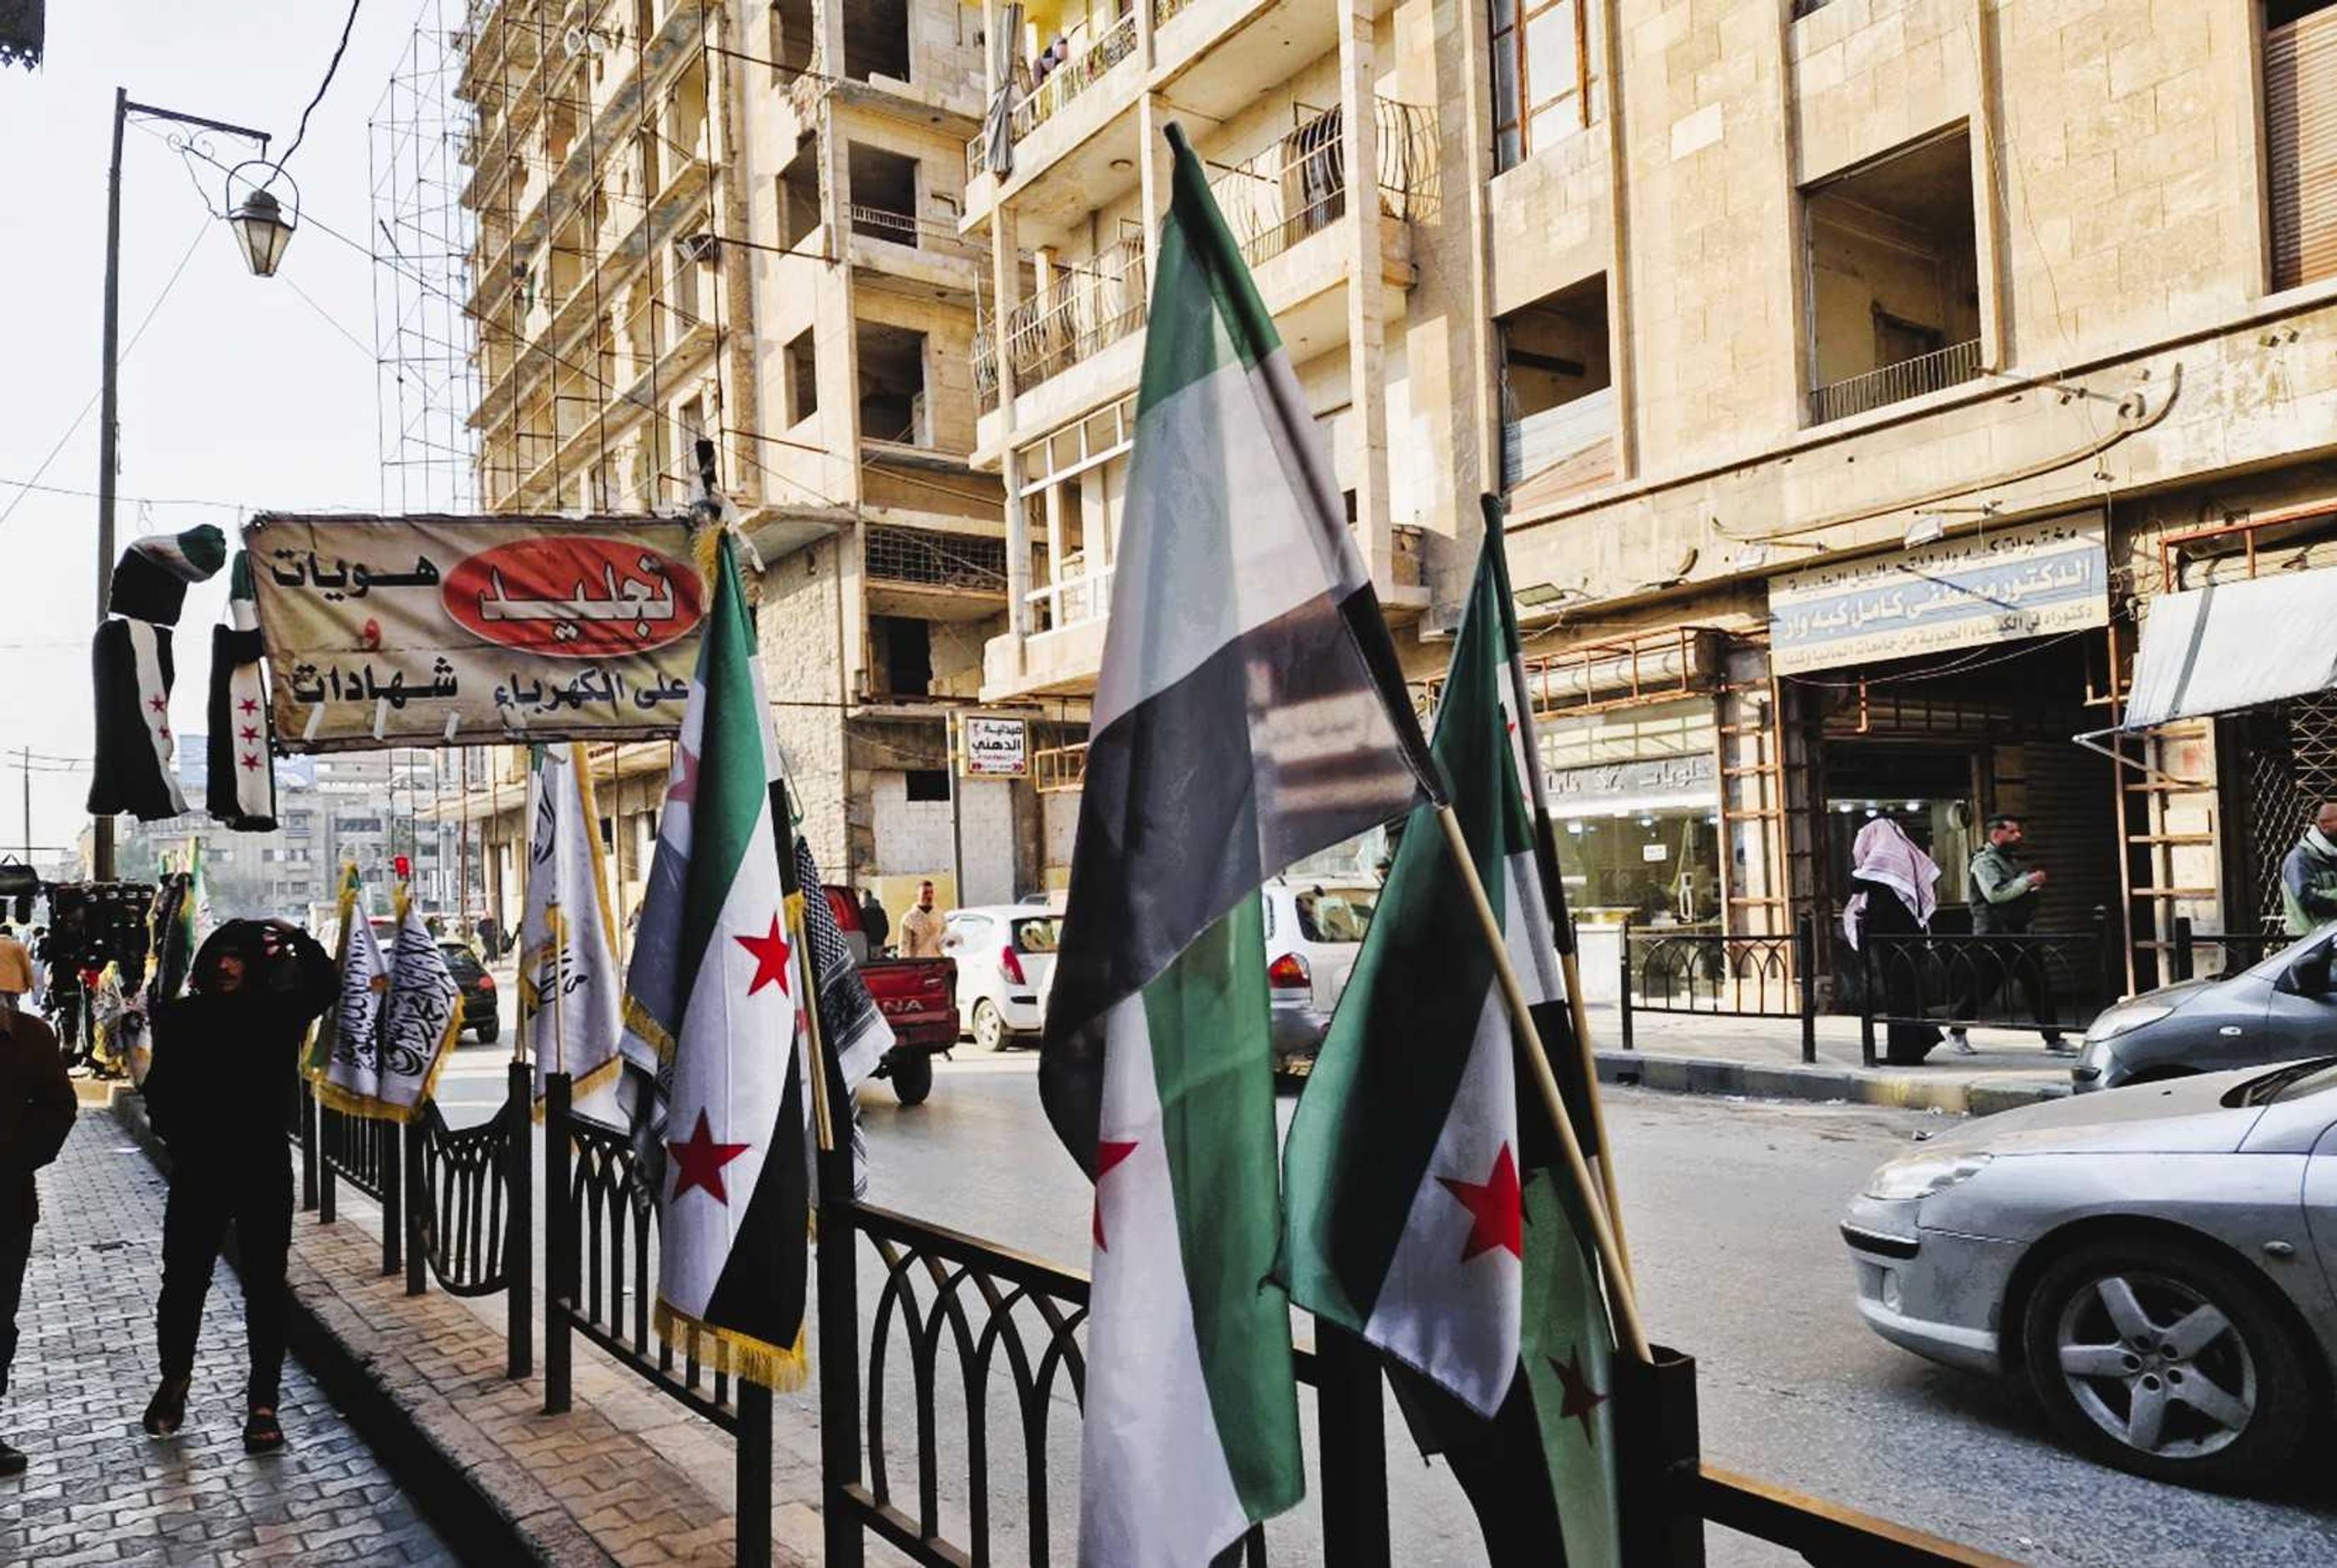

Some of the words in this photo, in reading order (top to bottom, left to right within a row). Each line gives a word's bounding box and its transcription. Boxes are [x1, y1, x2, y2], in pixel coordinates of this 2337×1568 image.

[271, 548, 440, 602] هويات
[477, 553, 675, 642] تجليد
[2002, 557, 2092, 603] الدكتور
[1851, 590, 1903, 628] كامل
[292, 657, 458, 709] شهادات
[494, 668, 625, 717] الكهرباء
[634, 672, 689, 709] على
